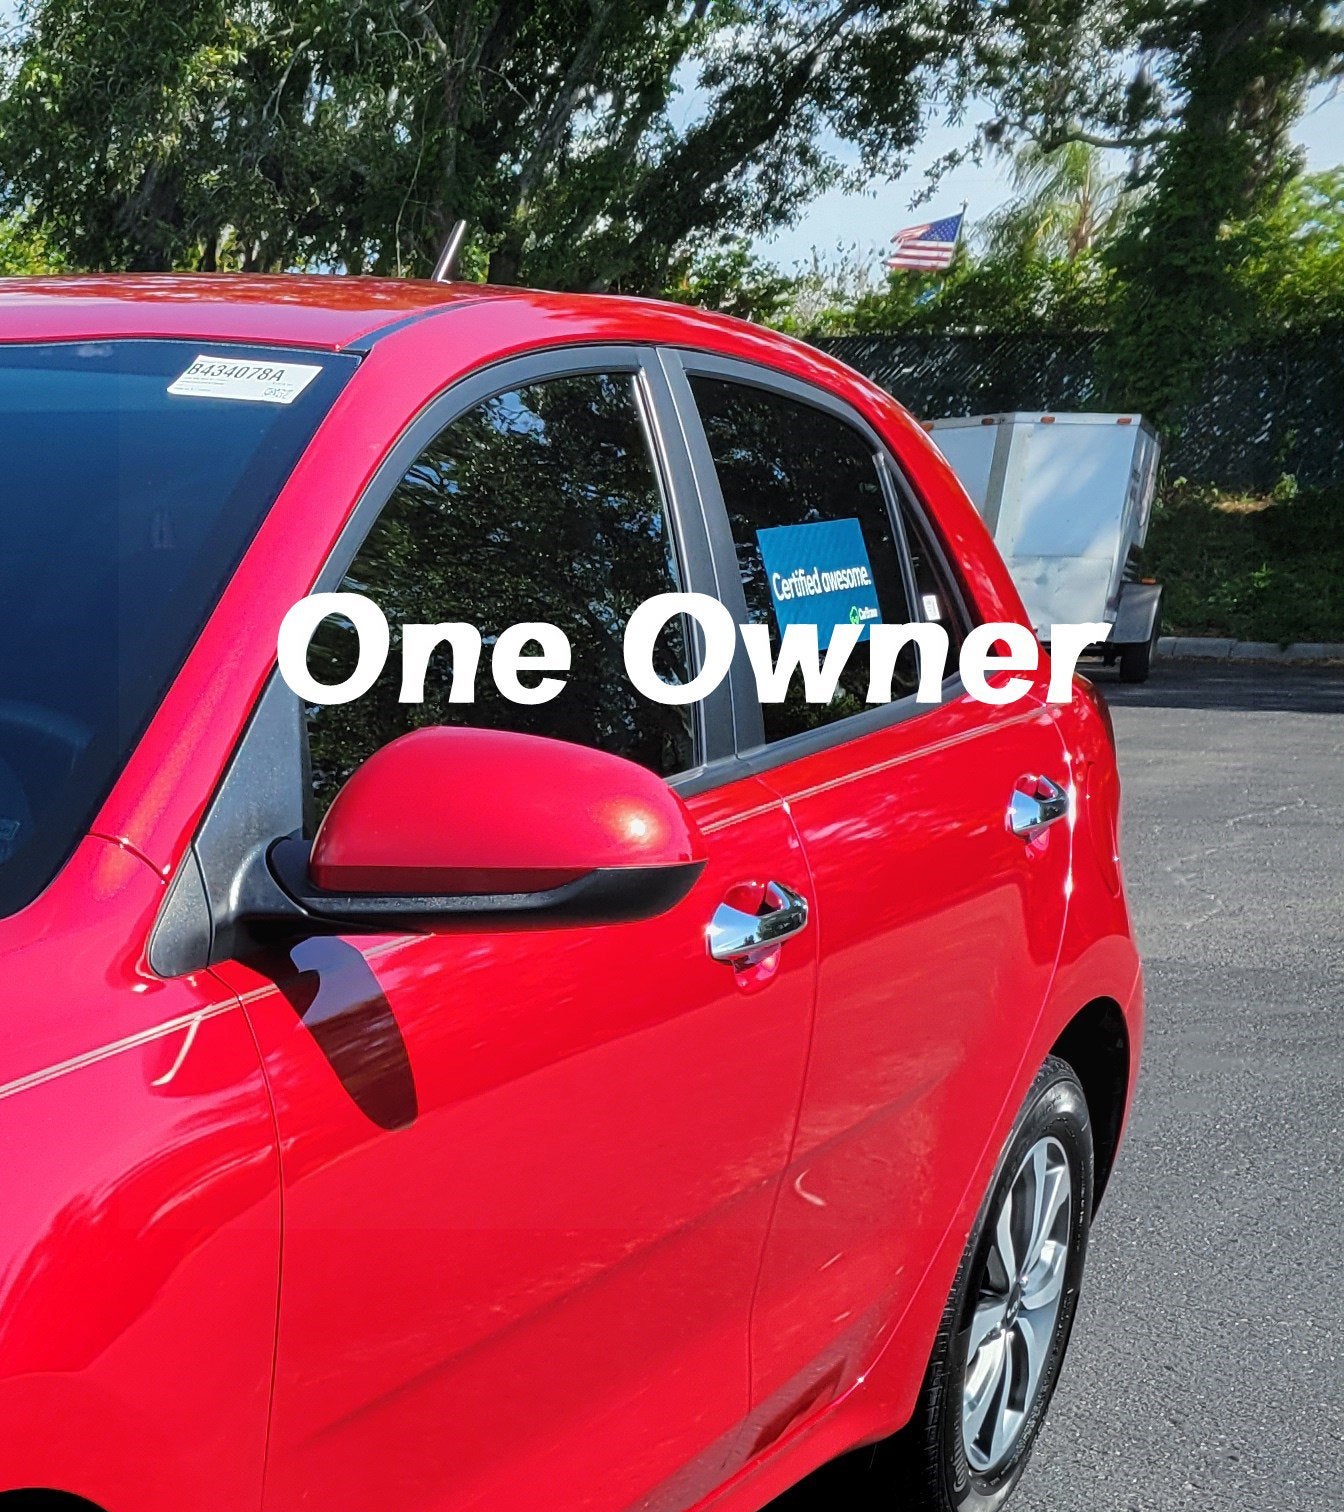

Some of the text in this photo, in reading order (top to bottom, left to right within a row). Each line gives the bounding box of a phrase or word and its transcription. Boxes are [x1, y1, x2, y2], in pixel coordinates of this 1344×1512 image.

[187, 363, 286, 382] B434078A
[773, 566, 872, 600] Certified awesome.
